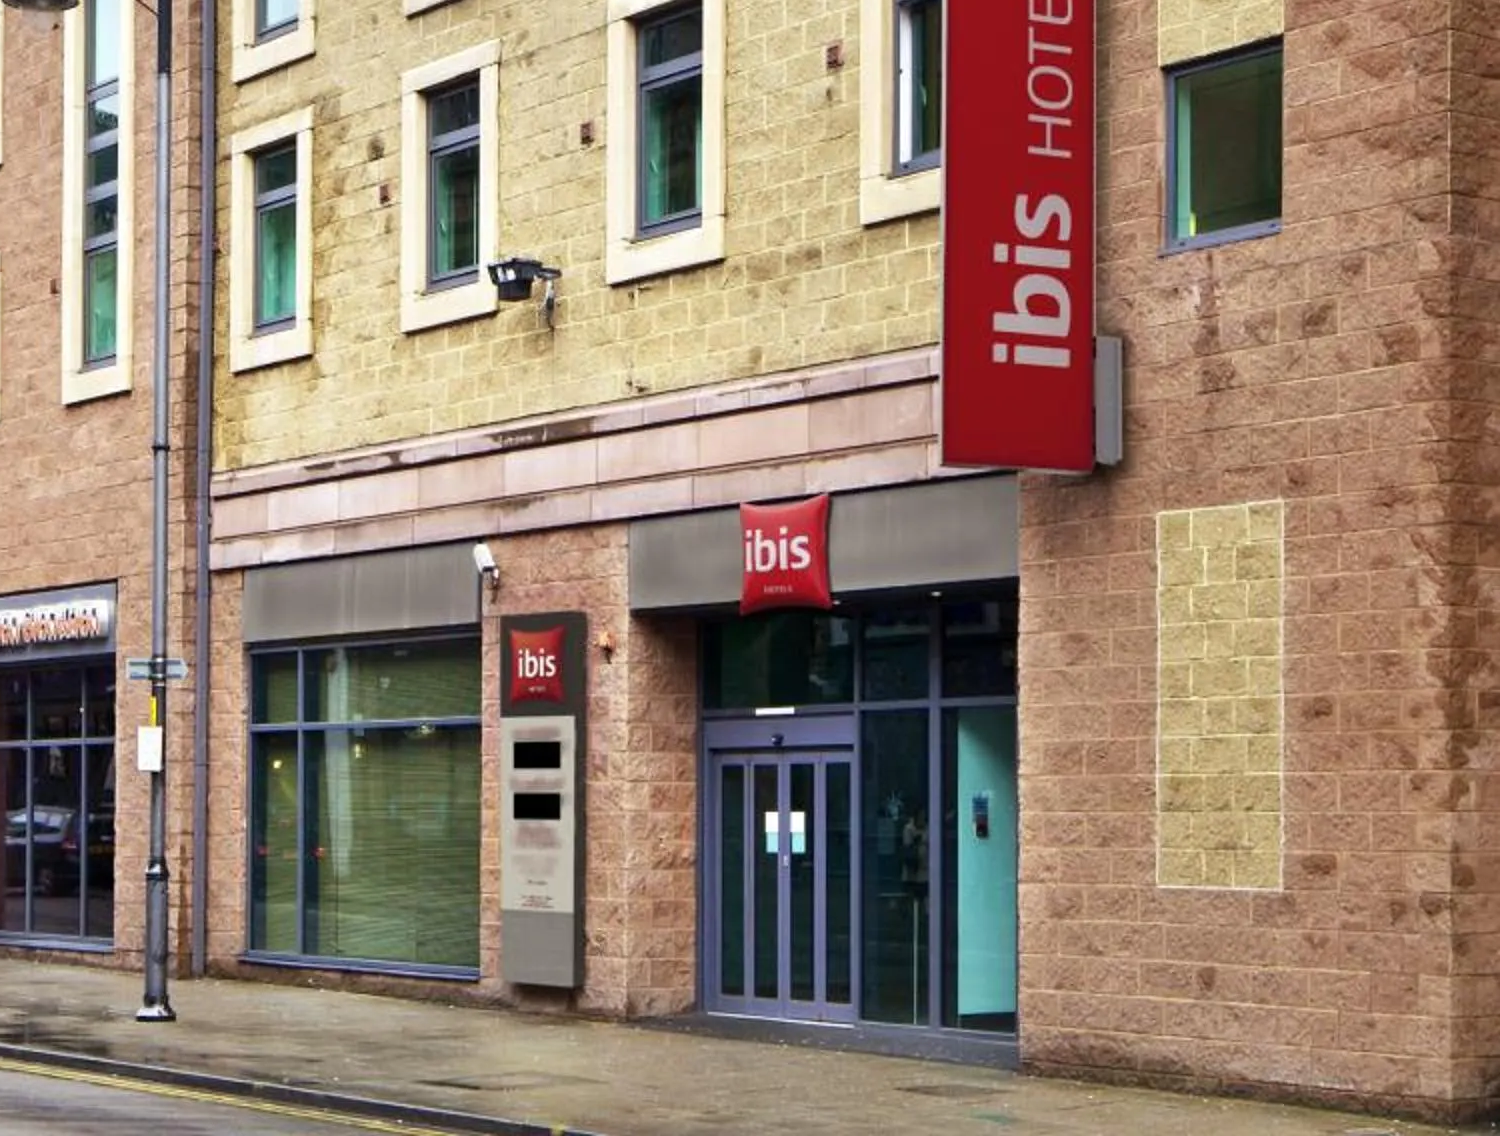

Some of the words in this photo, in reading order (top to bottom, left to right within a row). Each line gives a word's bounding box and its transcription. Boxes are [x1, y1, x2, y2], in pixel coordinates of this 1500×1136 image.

[993, 194, 1071, 368] ibis
[745, 526, 811, 573] ibis
[518, 647, 557, 678] ibis
